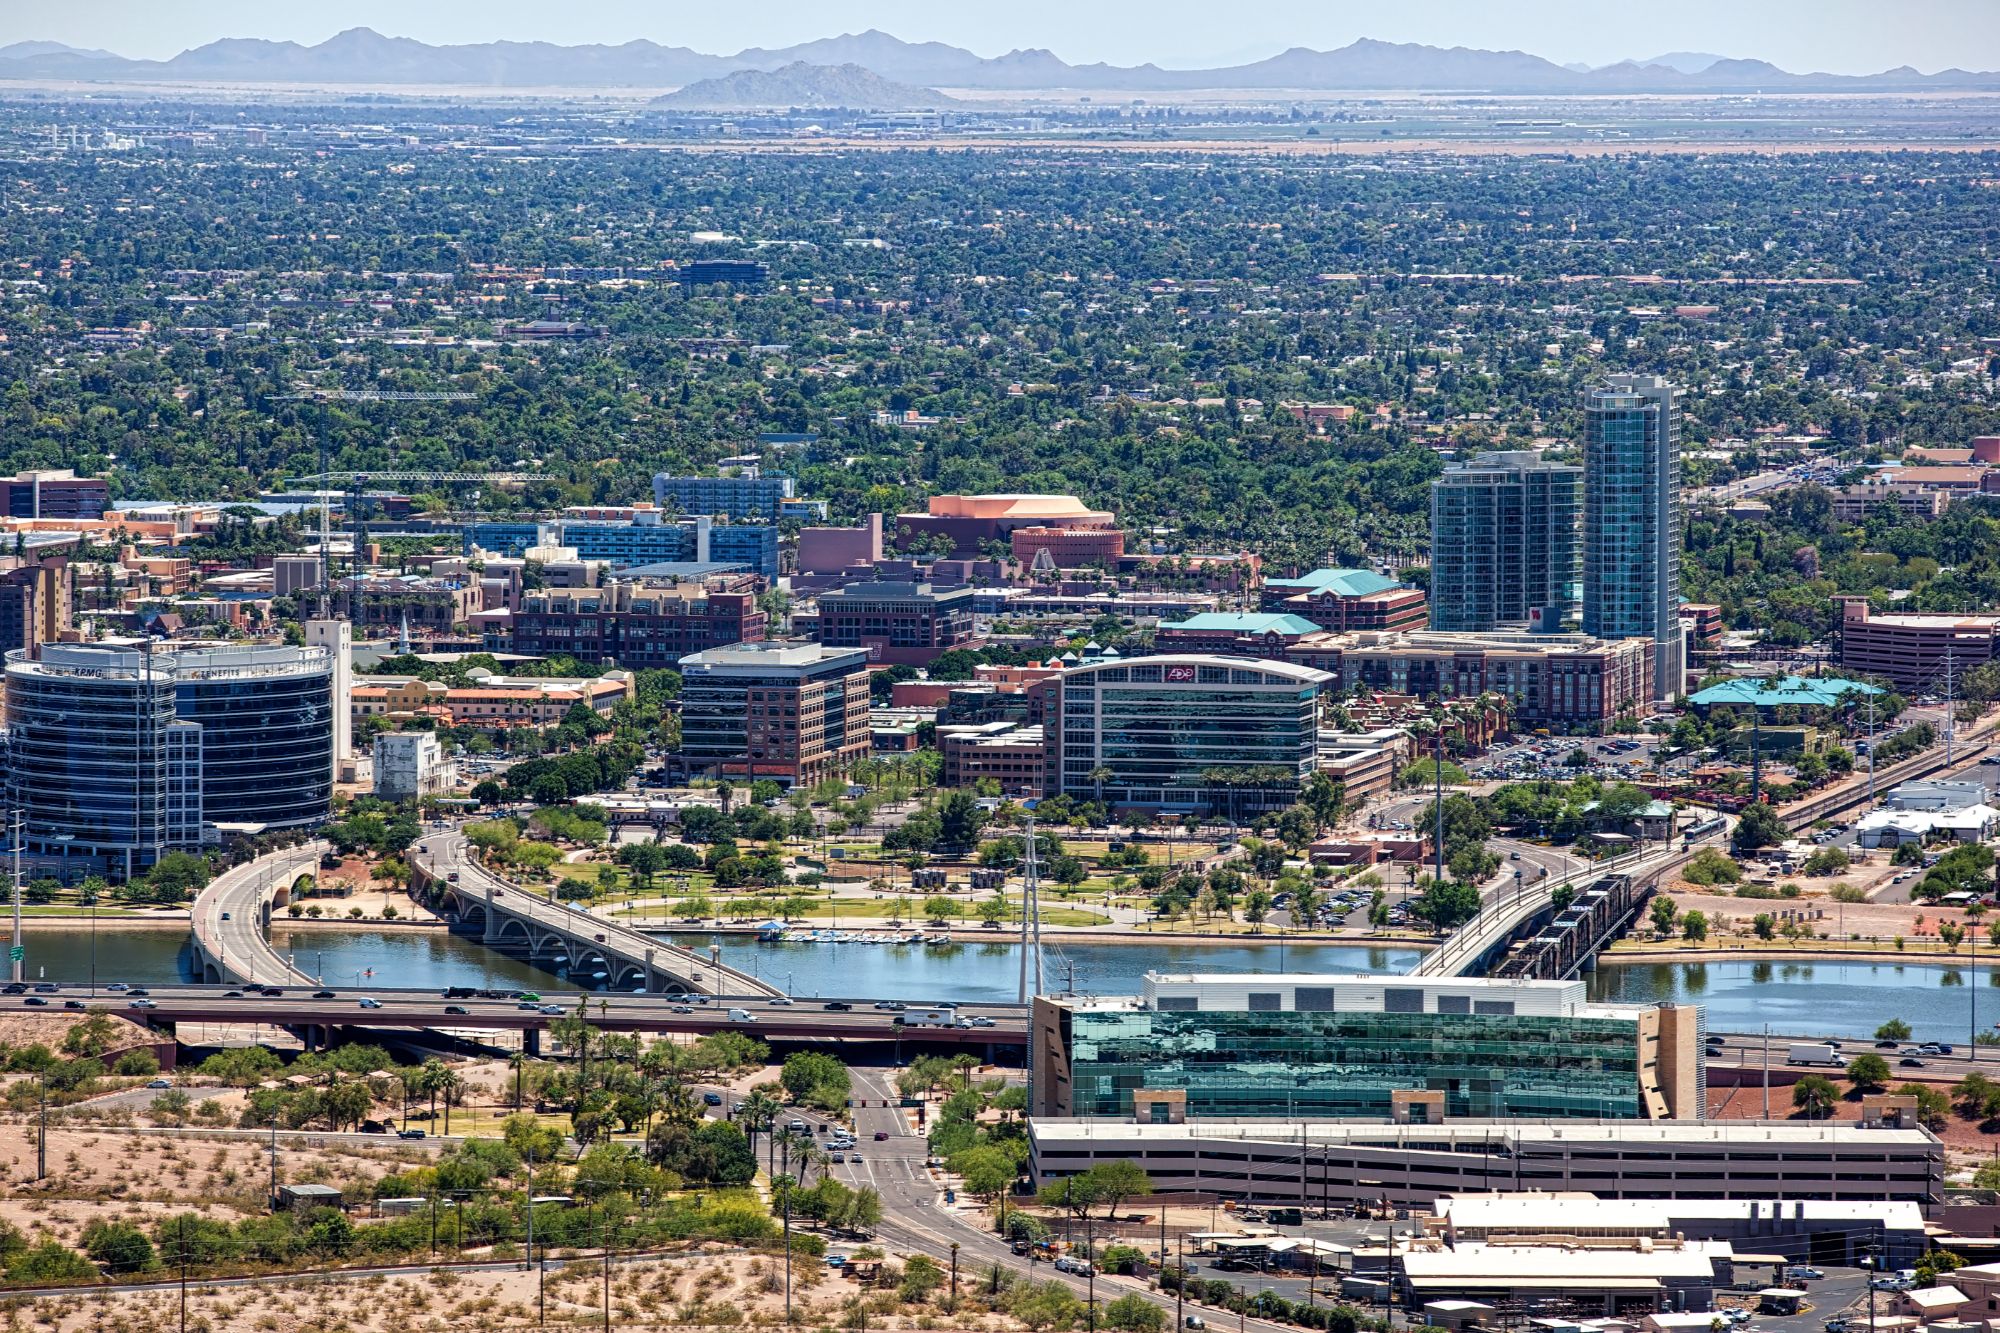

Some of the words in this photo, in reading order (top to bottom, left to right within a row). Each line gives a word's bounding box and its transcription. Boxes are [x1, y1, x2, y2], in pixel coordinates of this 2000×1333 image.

[75, 667, 102, 677] KPMG
[200, 669, 240, 679] ZENEFITS
[1168, 668, 1194, 680] ADP
